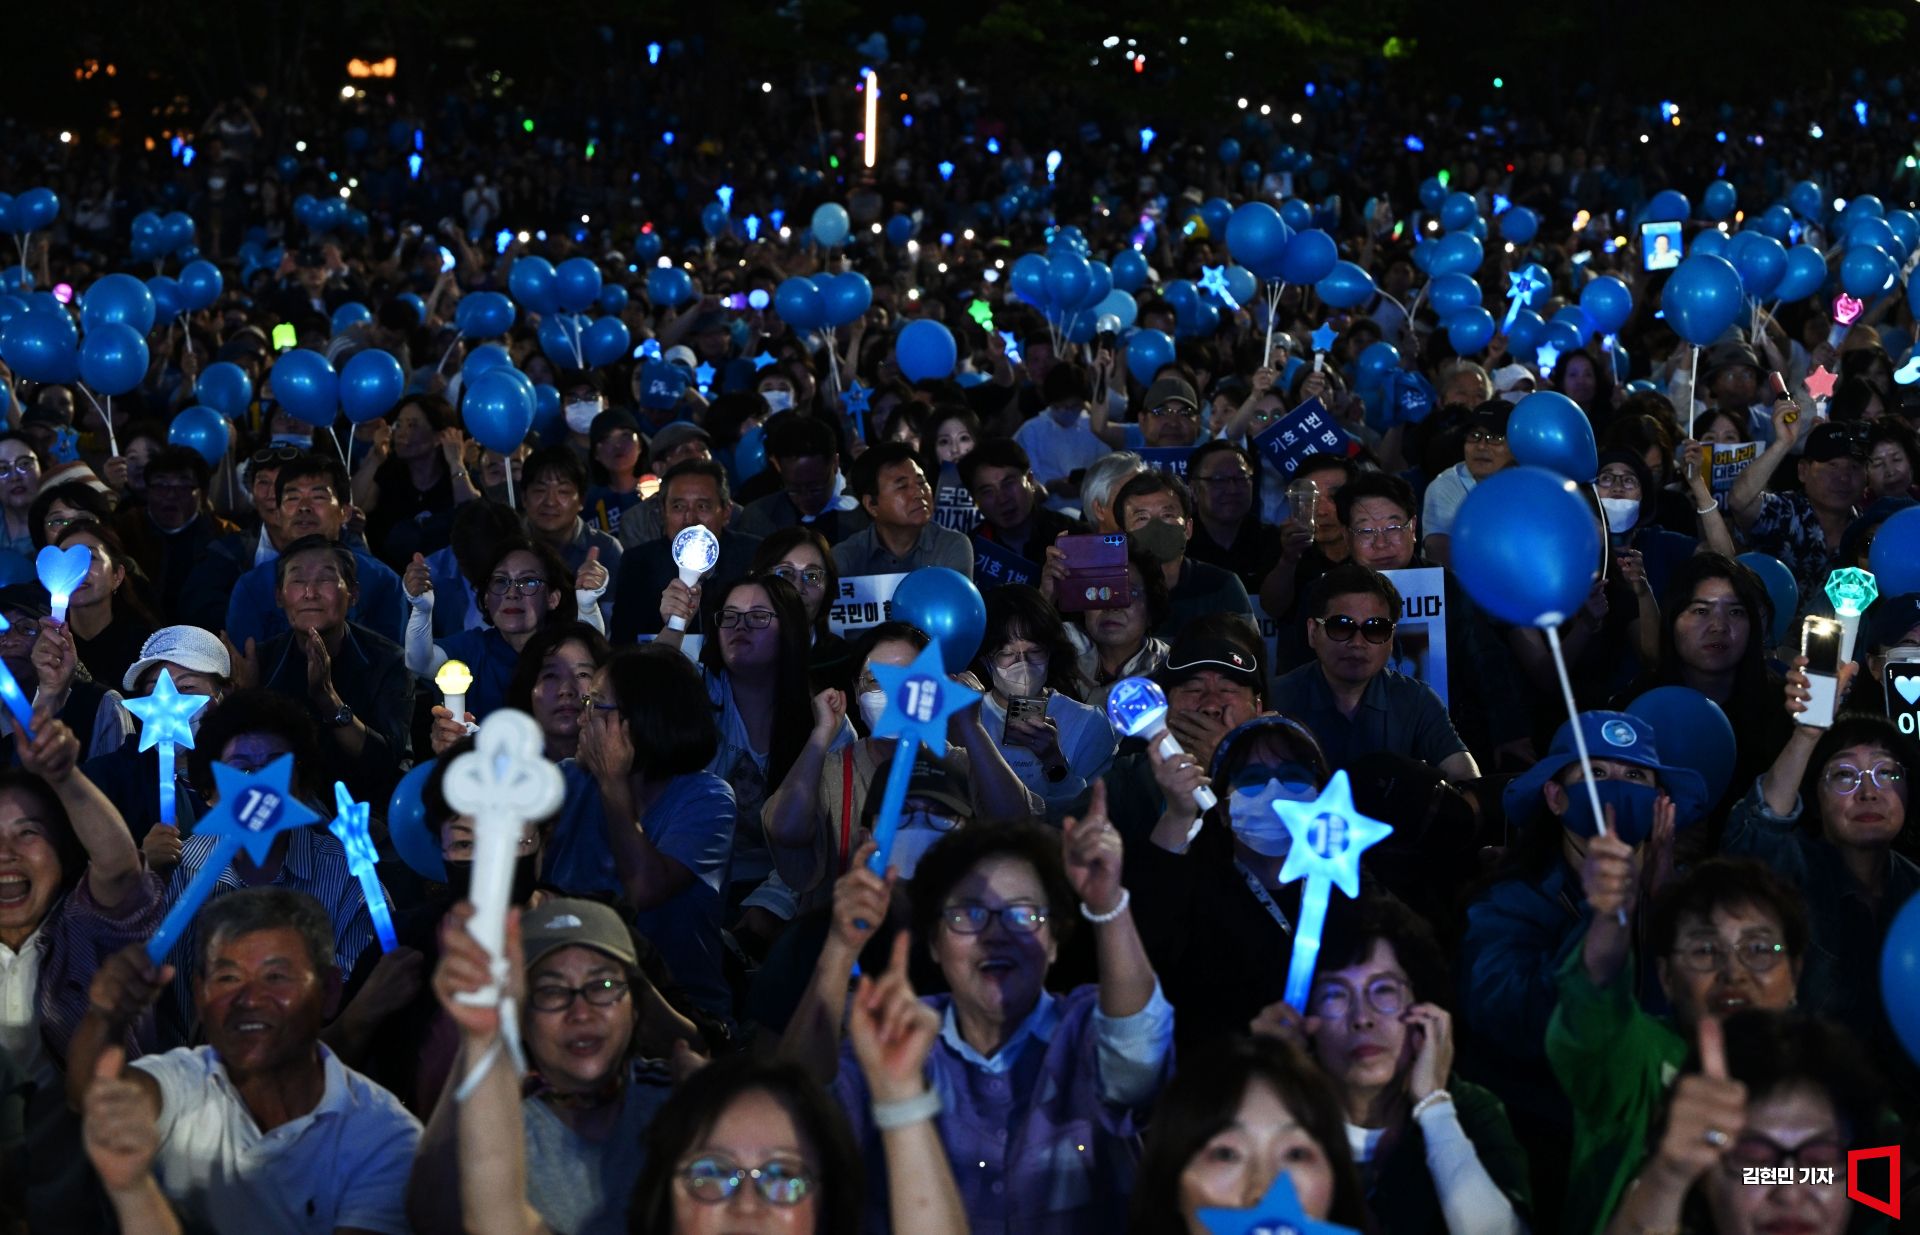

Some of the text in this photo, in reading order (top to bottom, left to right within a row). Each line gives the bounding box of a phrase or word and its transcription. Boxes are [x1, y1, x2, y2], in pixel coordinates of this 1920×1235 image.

[1269, 411, 1324, 454] 기호 1번
[974, 553, 1003, 578] 기호
[831, 602, 879, 625] 국민이
[1400, 595, 1443, 619] 니다
[905, 680, 920, 716] 1
[239, 789, 263, 822] 1
